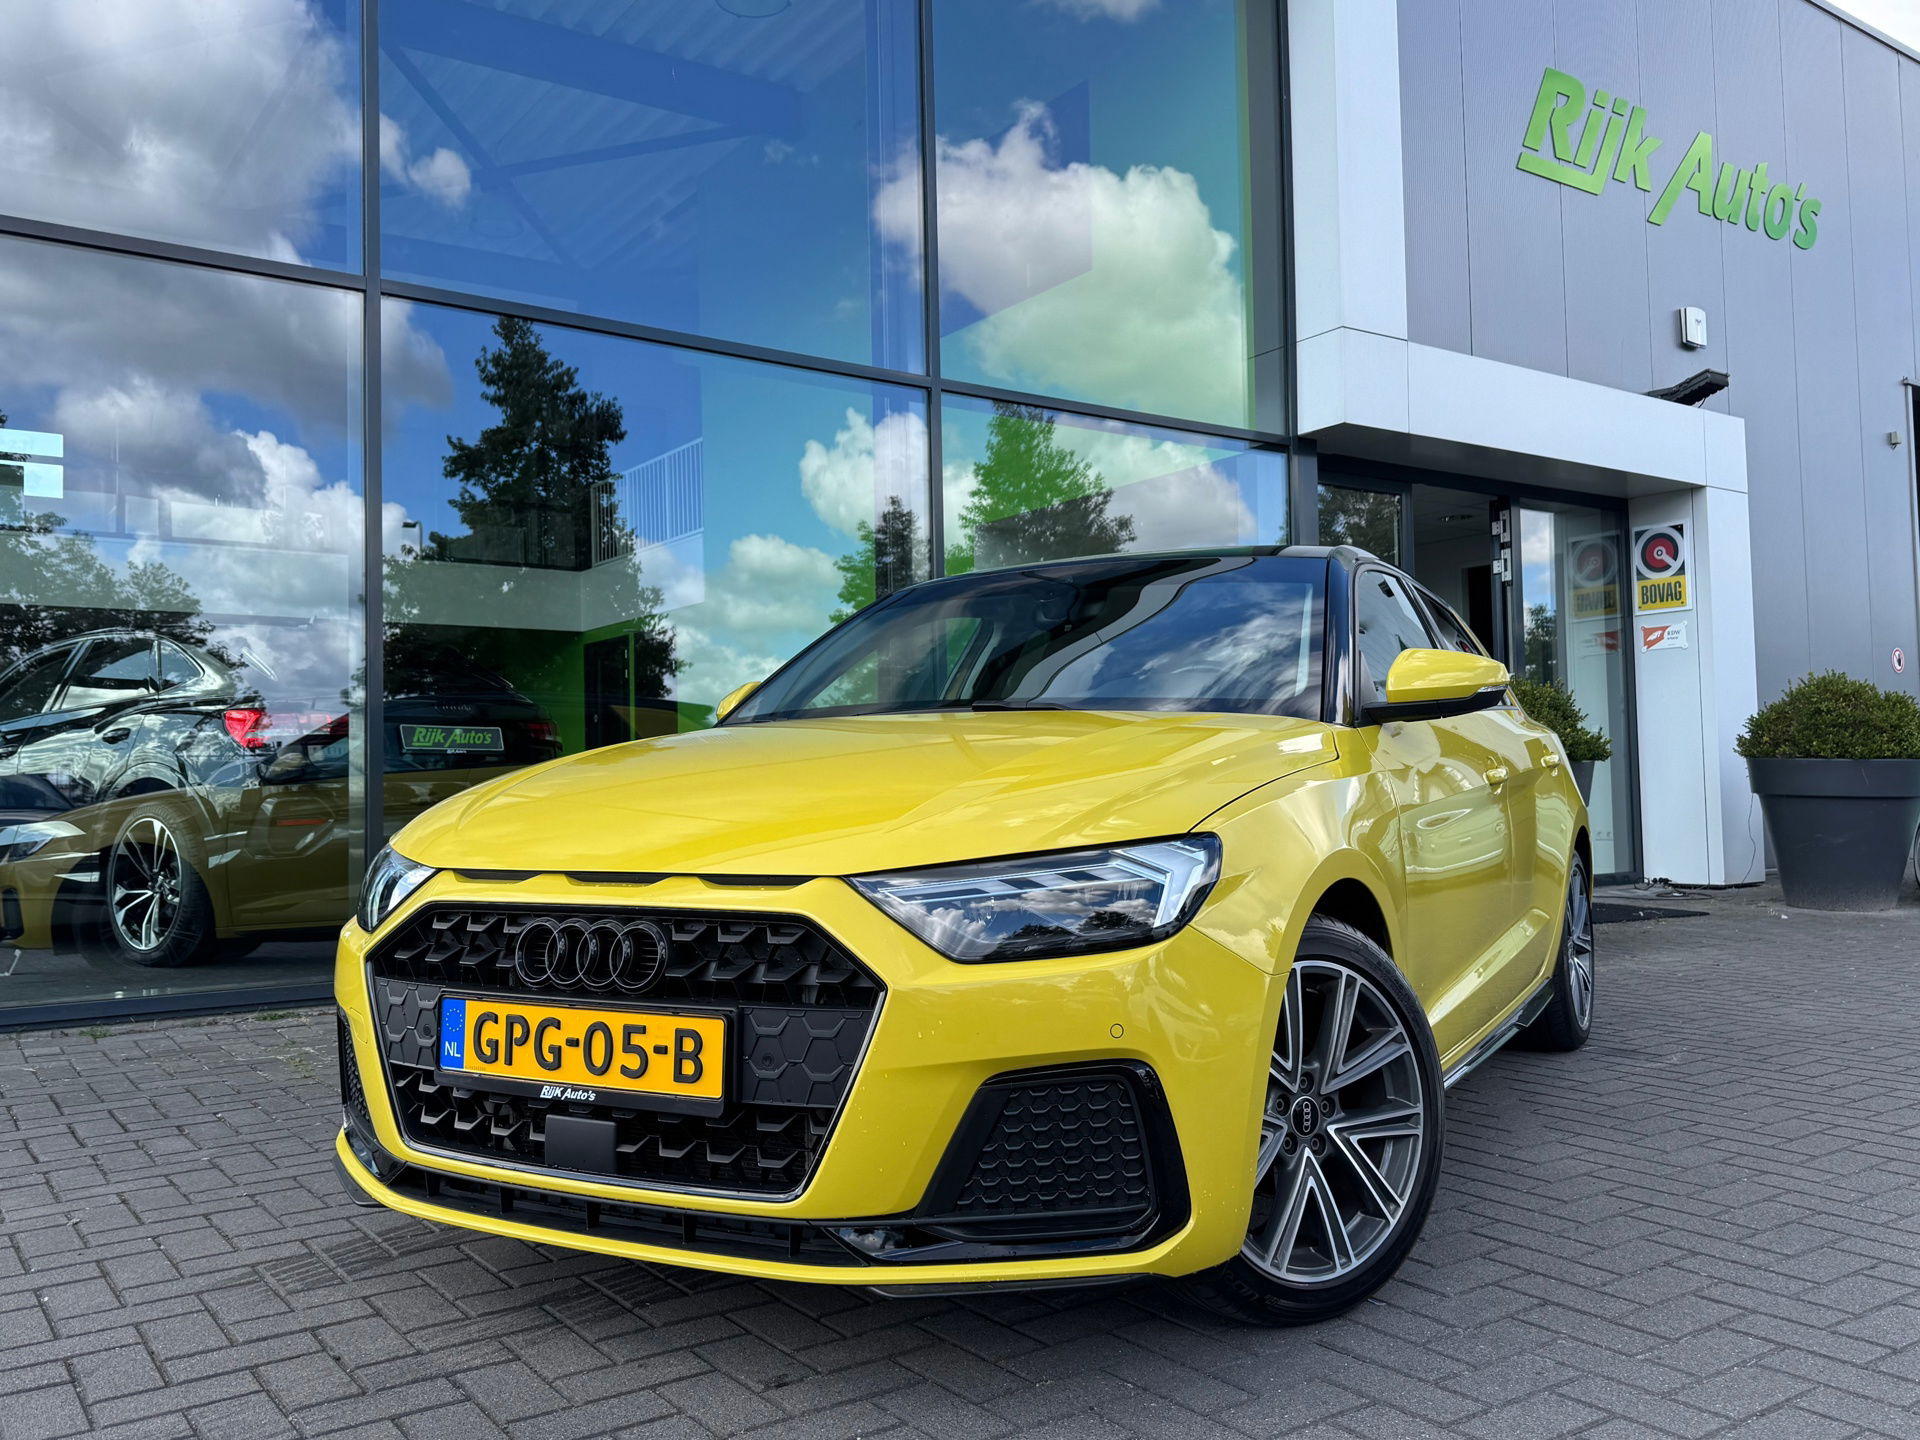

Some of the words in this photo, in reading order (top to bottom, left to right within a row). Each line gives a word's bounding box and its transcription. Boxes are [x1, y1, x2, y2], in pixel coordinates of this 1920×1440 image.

[1515, 66, 1664, 196] Rijk
[1647, 130, 1823, 251] Auto's
[1640, 580, 1683, 605] BOVAG
[411, 727, 446, 747] Rijk
[444, 728, 492, 748] Auto's
[444, 1040, 461, 1058] NL
[473, 1010, 704, 1085] GPG-05-B
[561, 1087, 596, 1101] Auto's
